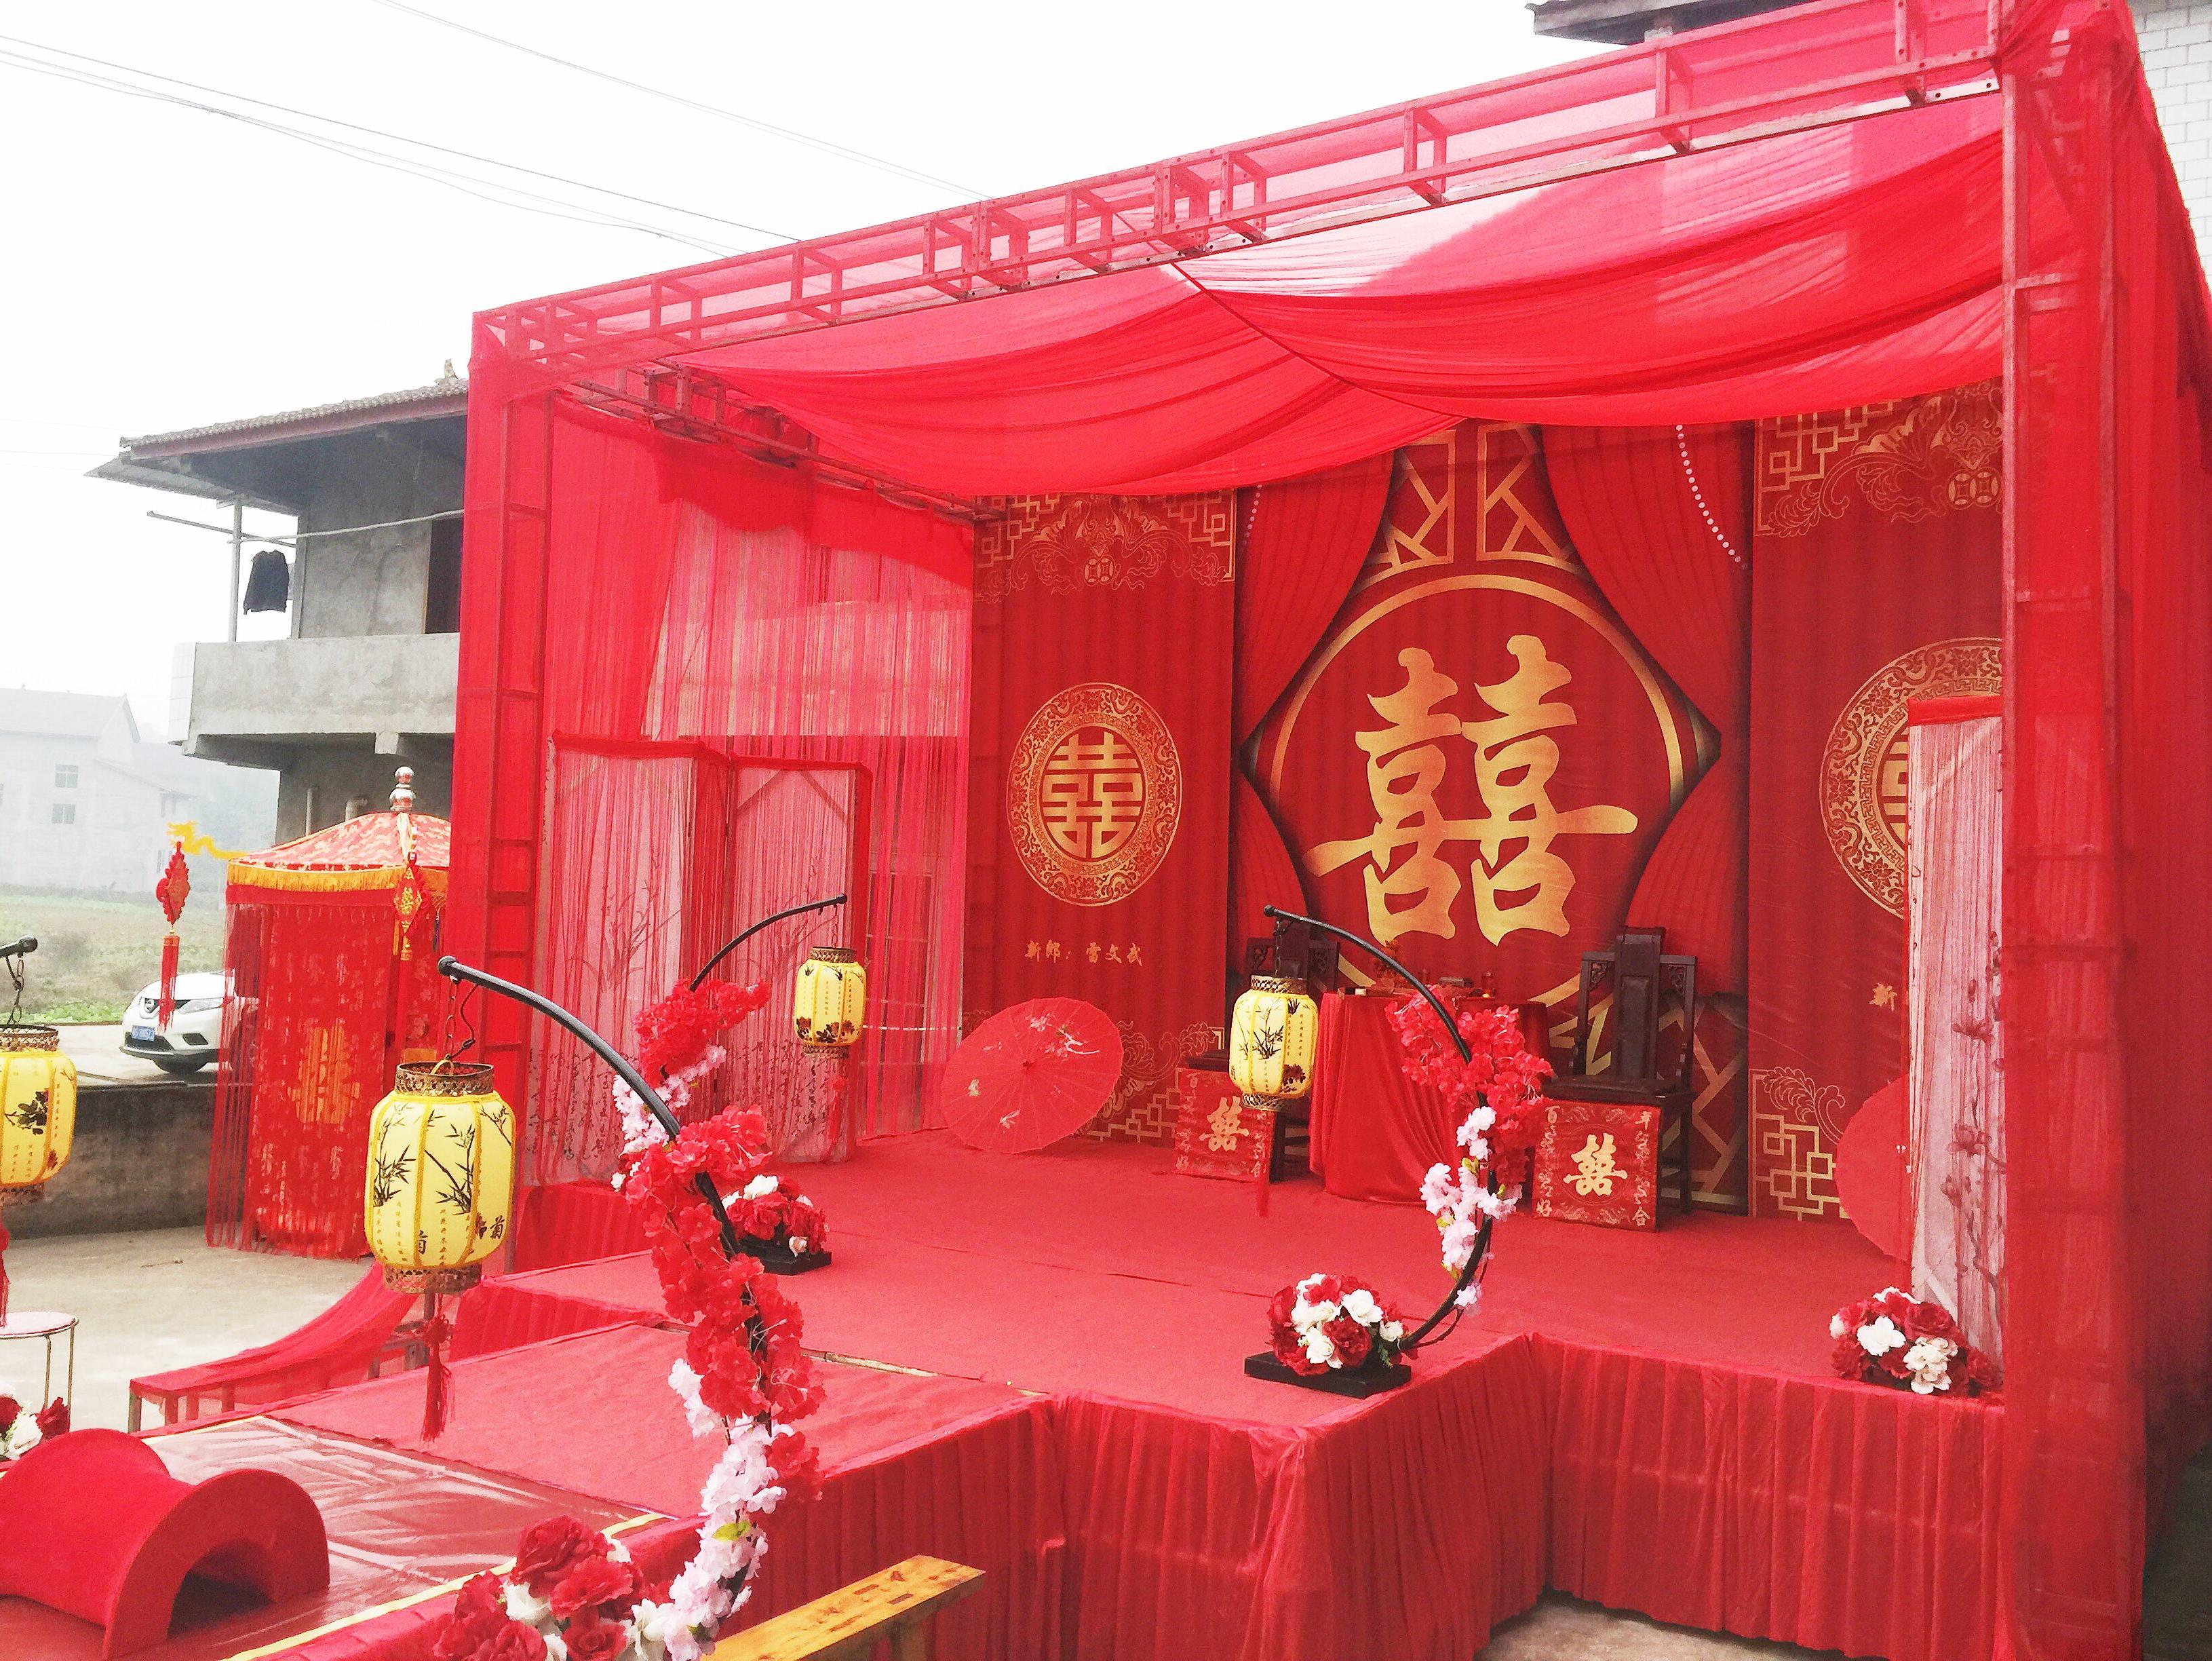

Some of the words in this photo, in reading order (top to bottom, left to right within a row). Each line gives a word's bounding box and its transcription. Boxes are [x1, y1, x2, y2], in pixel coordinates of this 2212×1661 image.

[1042, 731, 1143, 859] 囍
[1302, 634, 1638, 947] 囍
[1199, 1096, 1249, 1151] 囍
[1563, 1132, 1628, 1196] 囍
